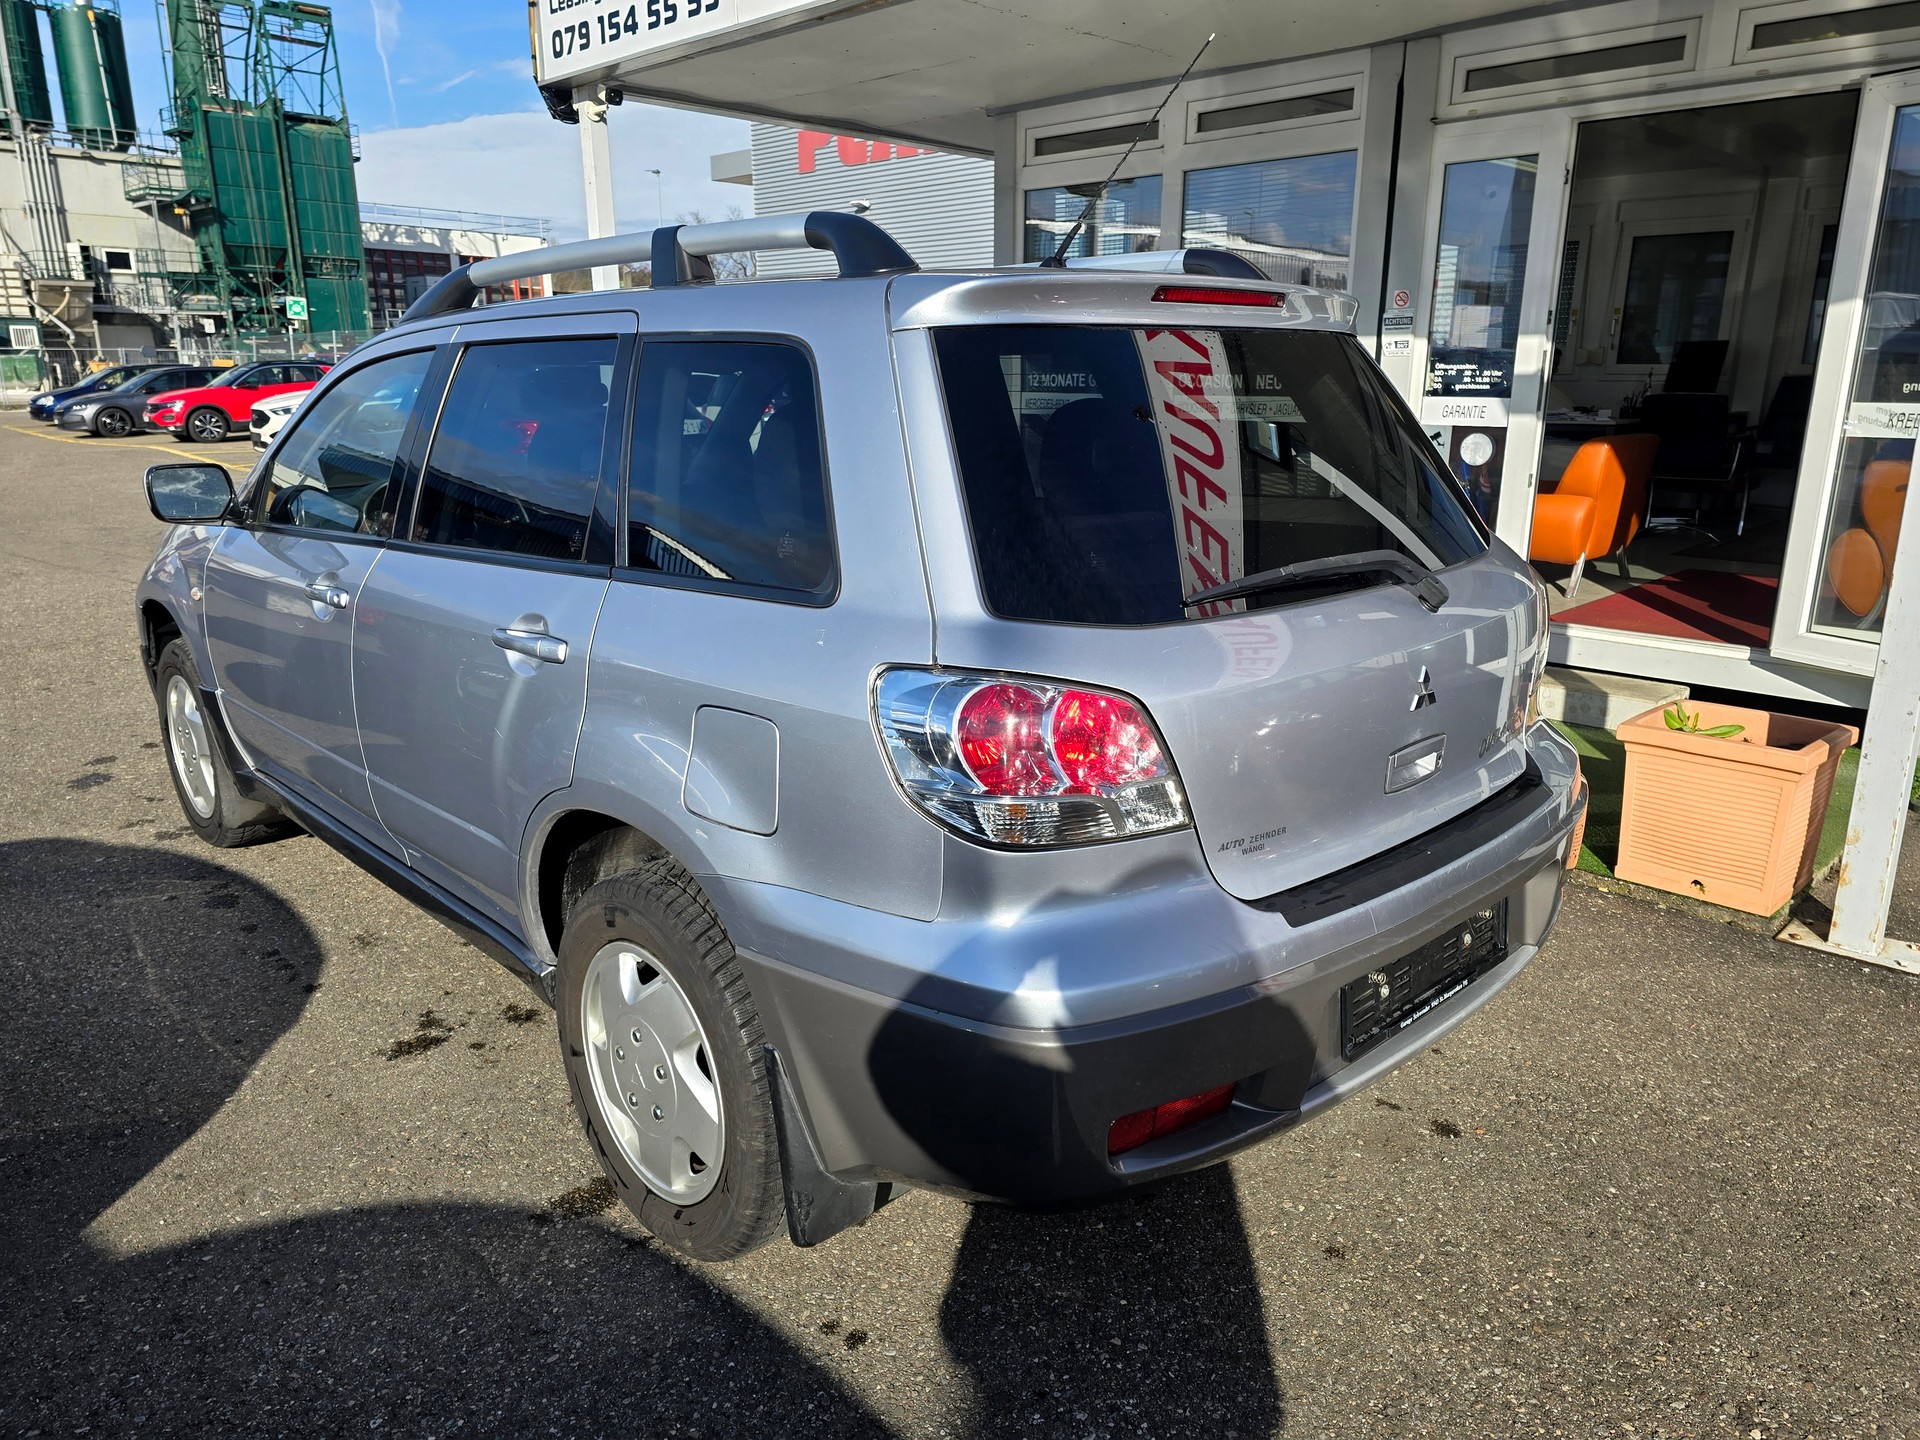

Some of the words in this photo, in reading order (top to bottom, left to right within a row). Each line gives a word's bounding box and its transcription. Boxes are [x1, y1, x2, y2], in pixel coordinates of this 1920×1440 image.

[552, 21, 591, 59] 079
[597, 4, 639, 45] 154
[647, 0, 678, 30] 55
[1385, 317, 1412, 326] ACHTUNG
[1029, 374, 1040, 387] 12
[1040, 373, 1087, 387] MONATE
[1178, 373, 1243, 389] OCCASION
[1455, 382, 1491, 391] geschlossen
[1230, 402, 1268, 415] CHRYSLER
[1441, 404, 1488, 419] GARANTIE
[1217, 838, 1245, 852] AUTO
[1249, 827, 1287, 844] ZEHNDER
[1241, 843, 1266, 856] WÄNGI
